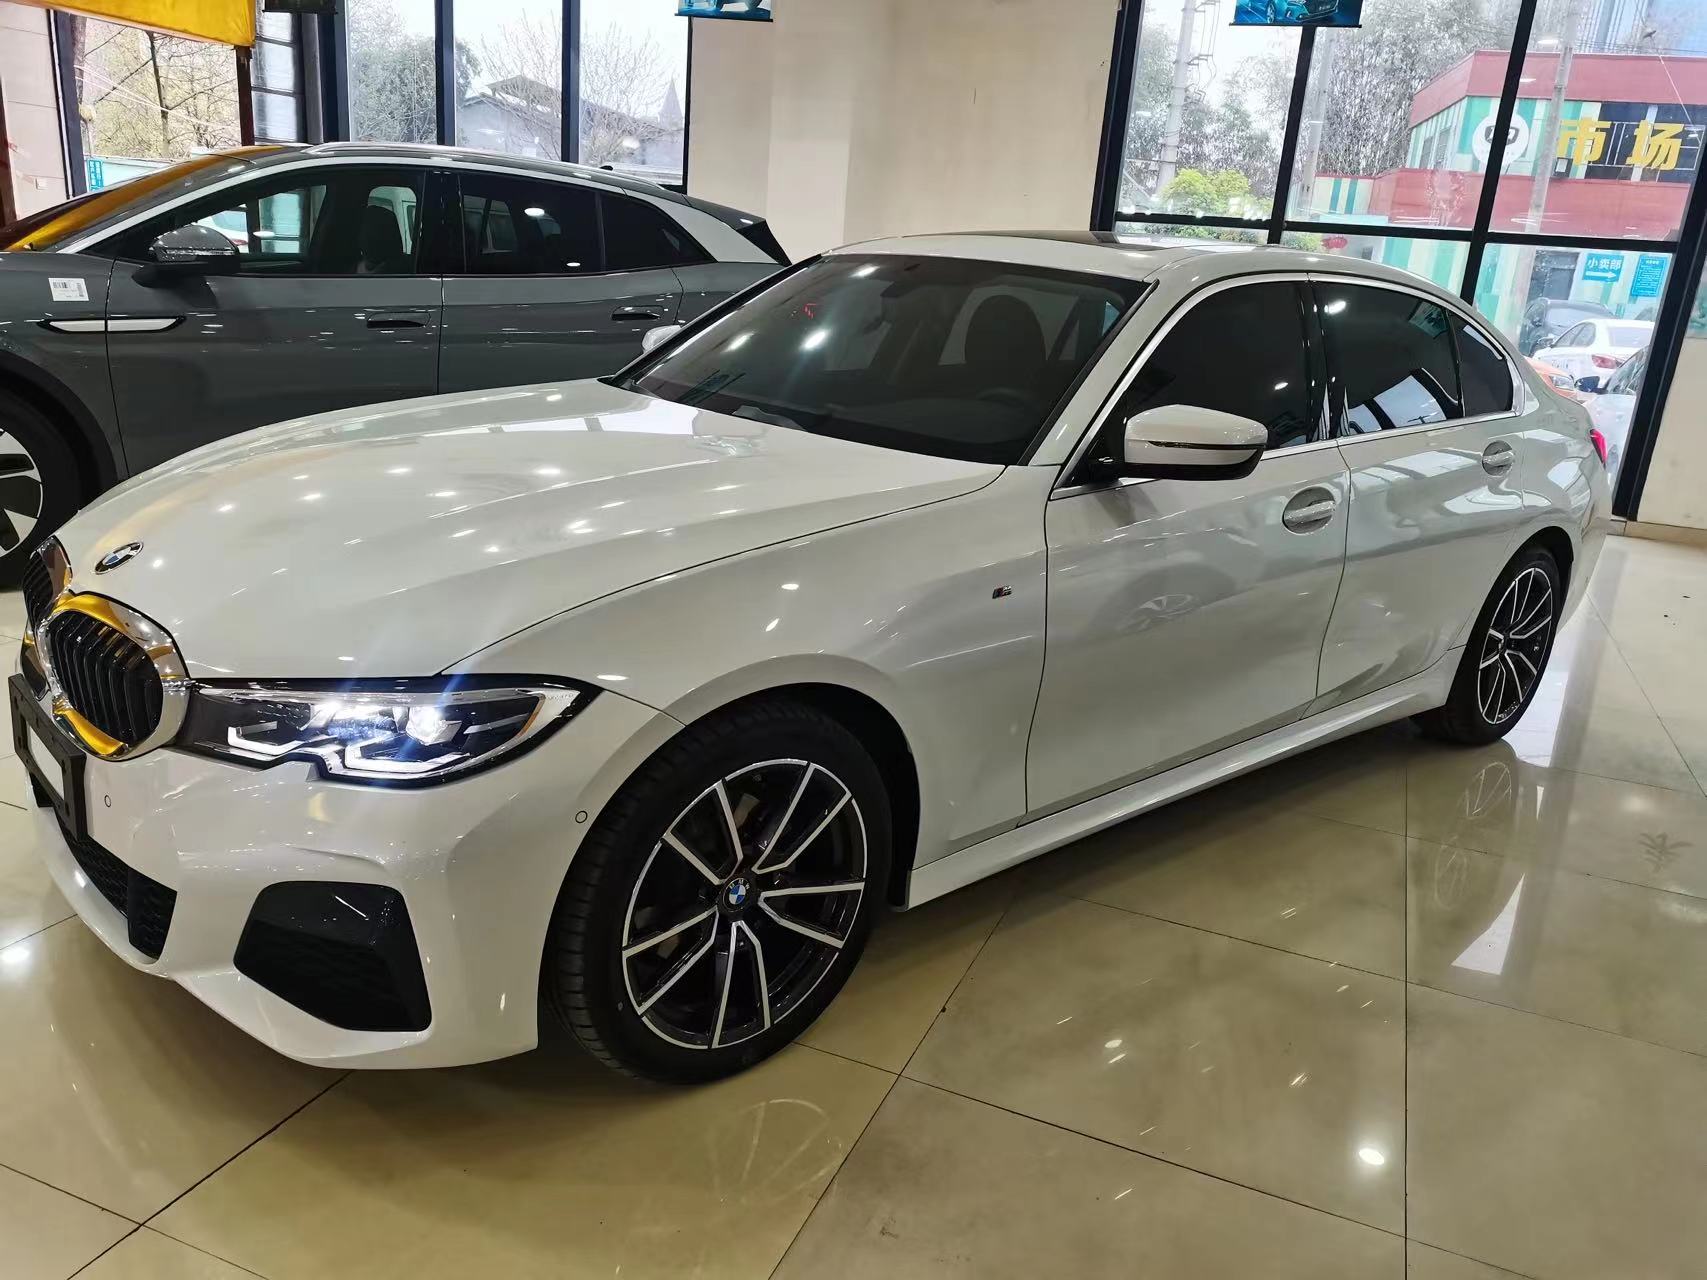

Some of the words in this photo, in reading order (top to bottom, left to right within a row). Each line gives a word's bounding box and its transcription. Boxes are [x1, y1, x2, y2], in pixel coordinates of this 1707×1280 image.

[1557, 118, 1685, 171] 市场
[1588, 258, 1622, 270] 小卖部
